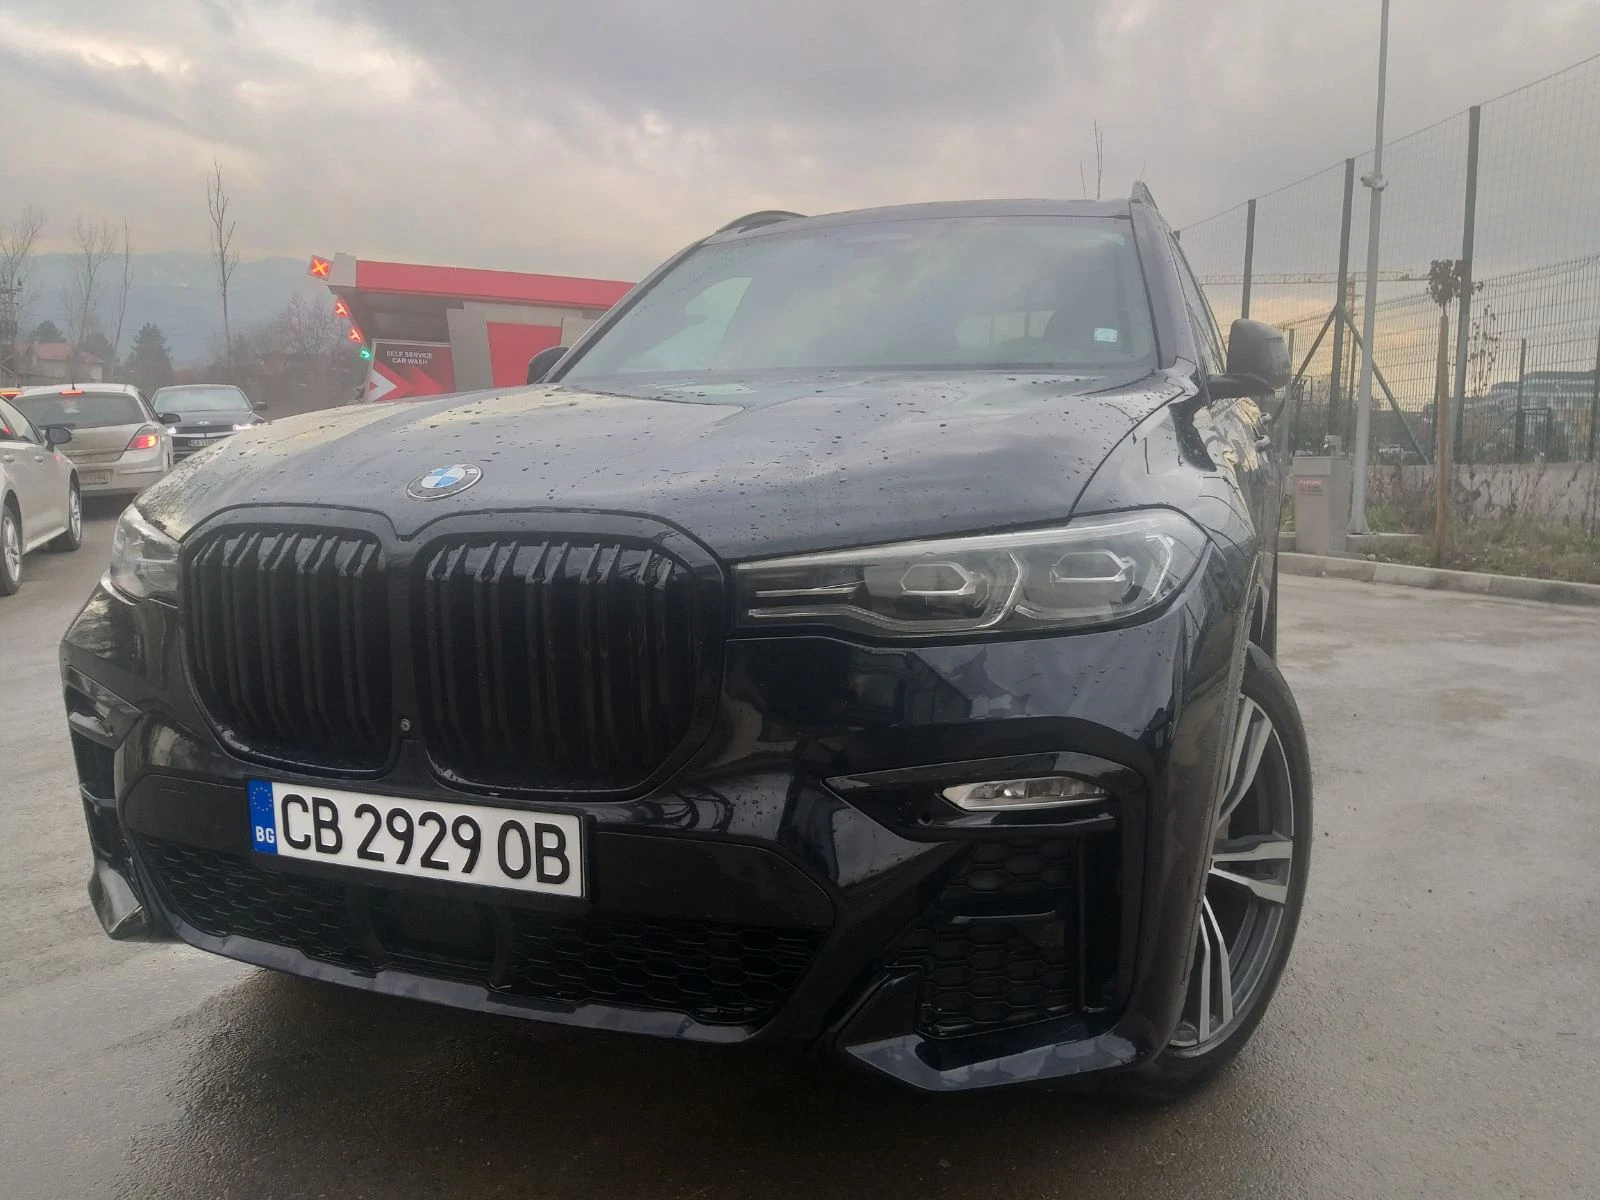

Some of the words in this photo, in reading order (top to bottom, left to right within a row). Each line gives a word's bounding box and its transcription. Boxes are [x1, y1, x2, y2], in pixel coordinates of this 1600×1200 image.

[404, 351, 433, 359] SERVICE
[255, 825, 275, 844] BG
[281, 793, 343, 855] CB
[354, 803, 482, 874] 2929
[497, 819, 571, 885] OB
